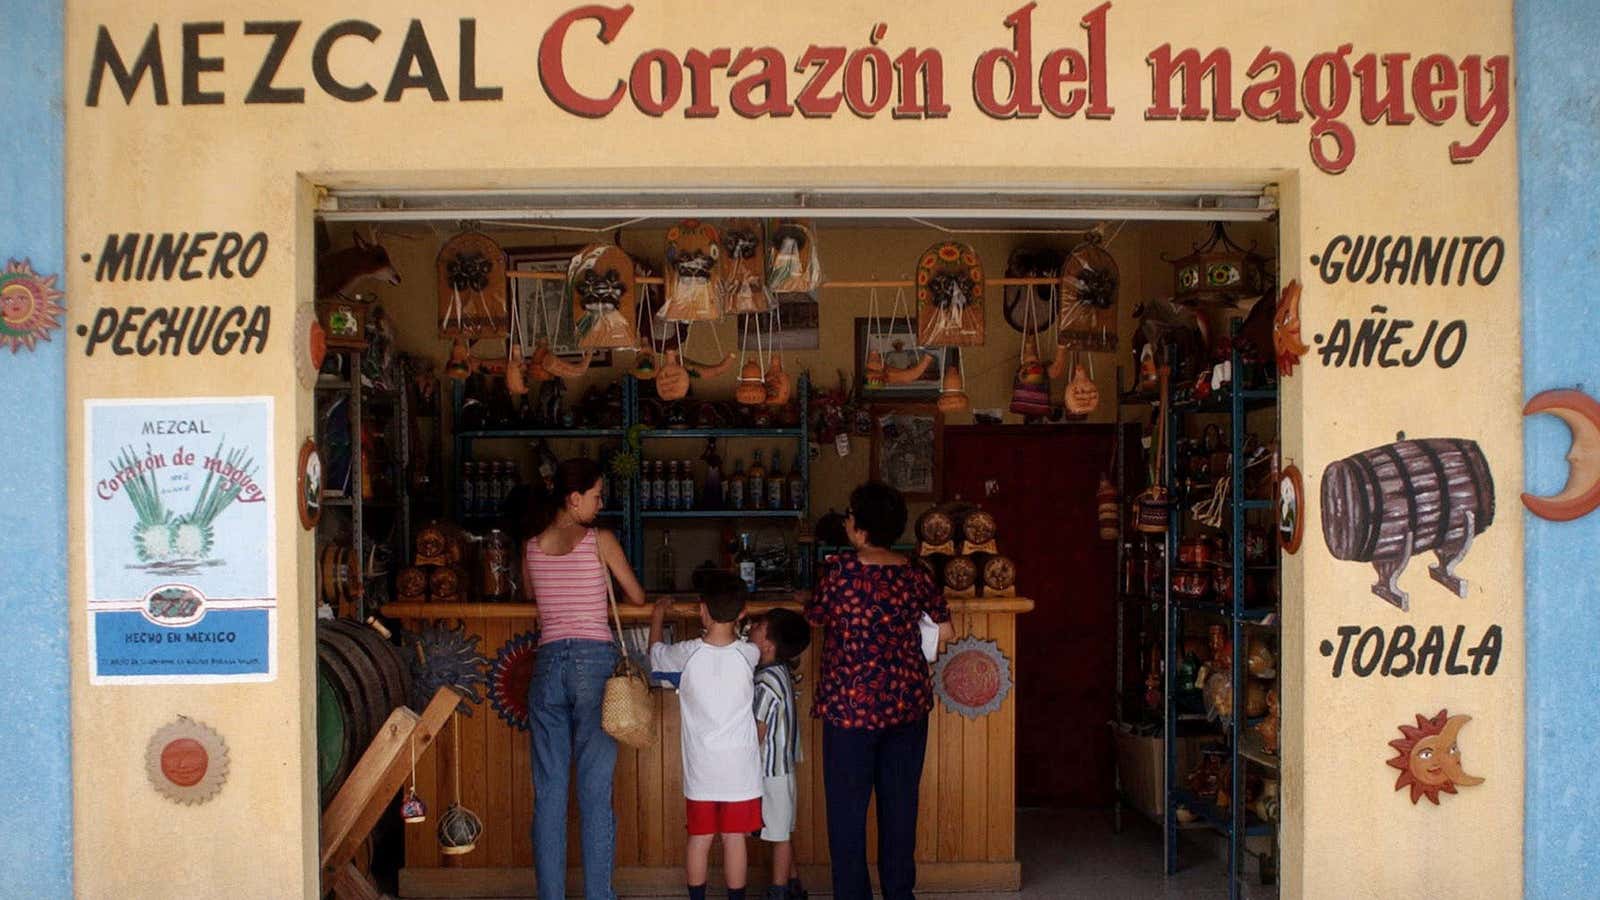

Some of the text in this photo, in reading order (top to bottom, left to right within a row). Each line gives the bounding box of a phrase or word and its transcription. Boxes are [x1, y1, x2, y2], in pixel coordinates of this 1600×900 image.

[85, 1, 1511, 175] MEZCAL Corazón del maguey
[95, 231, 269, 282] MINERO
[1319, 234, 1506, 287] GUSANITO
[85, 305, 271, 357] PECHUGA
[1318, 304, 1468, 369] AÑEJO
[141, 419, 212, 435] MEZCAL
[172, 445, 195, 466] de
[203, 456, 266, 503] maguey
[125, 631, 236, 644] HECHO EN MEXICO
[1332, 624, 1503, 678] TOBALA
